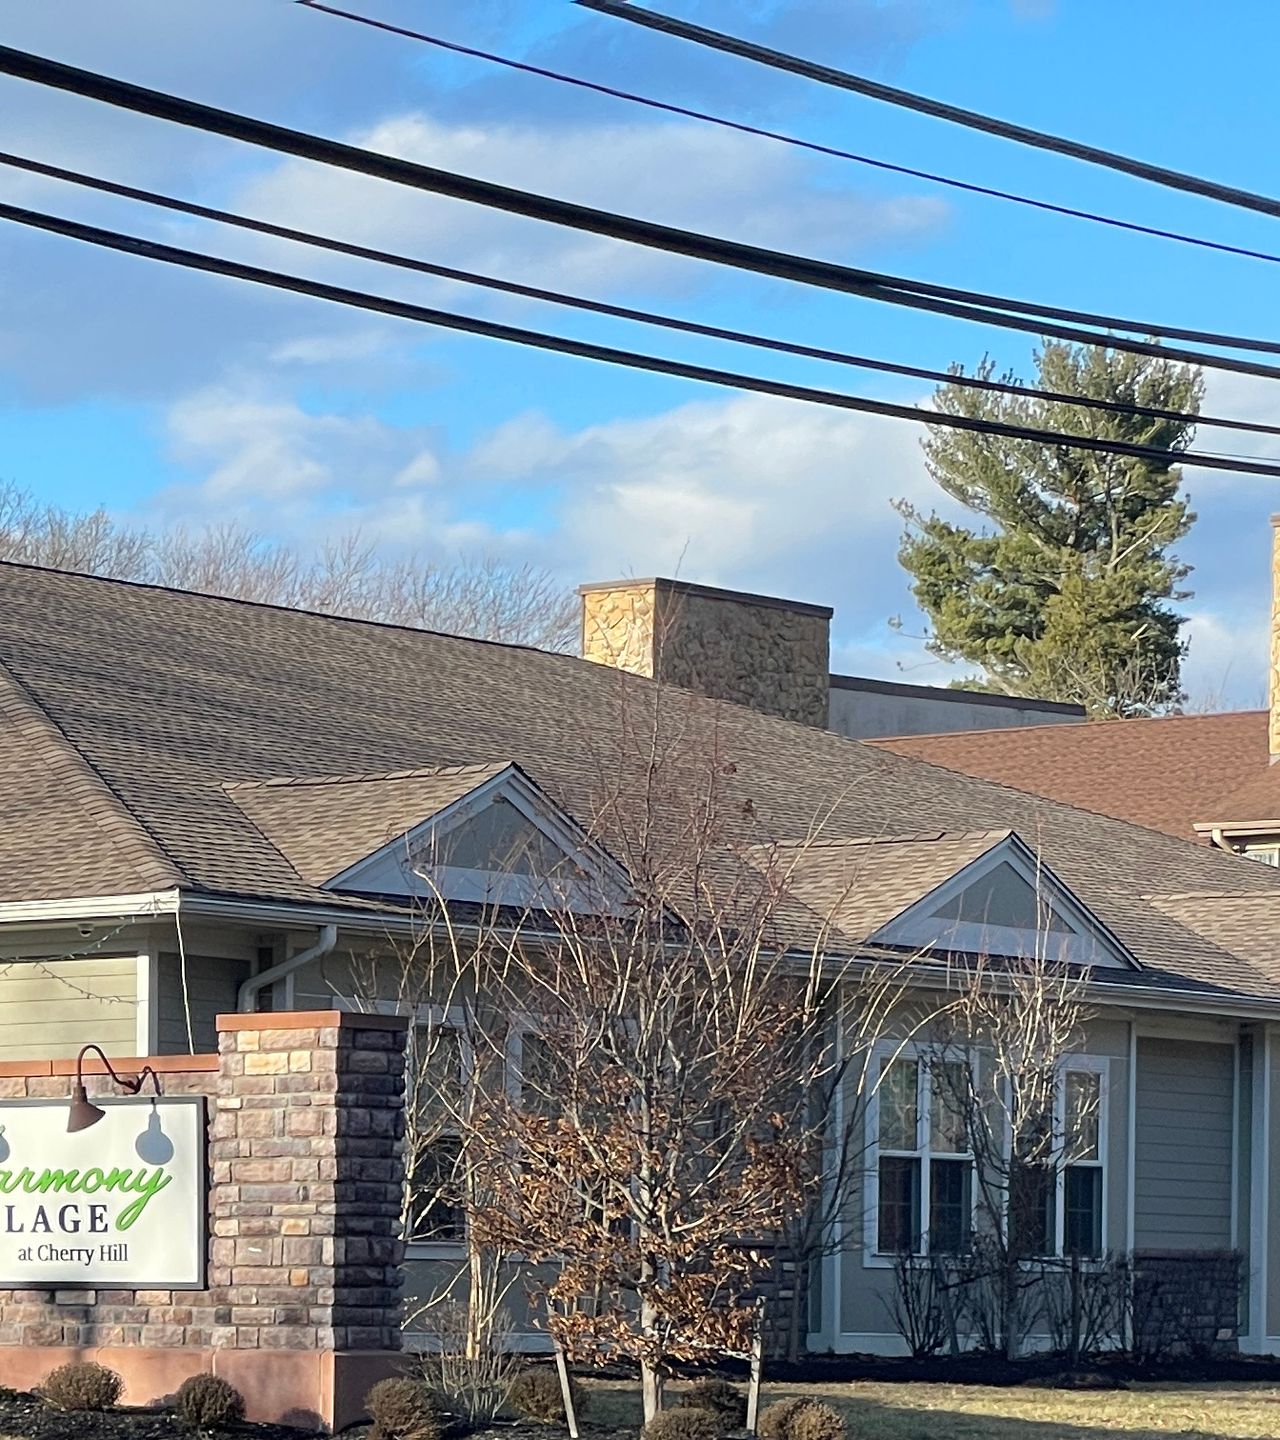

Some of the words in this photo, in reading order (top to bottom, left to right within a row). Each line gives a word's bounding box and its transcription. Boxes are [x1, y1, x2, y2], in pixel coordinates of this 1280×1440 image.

[18, 1246, 33, 1261] at
[37, 1244, 95, 1266] Cherry
[99, 1243, 129, 1262] Hill
